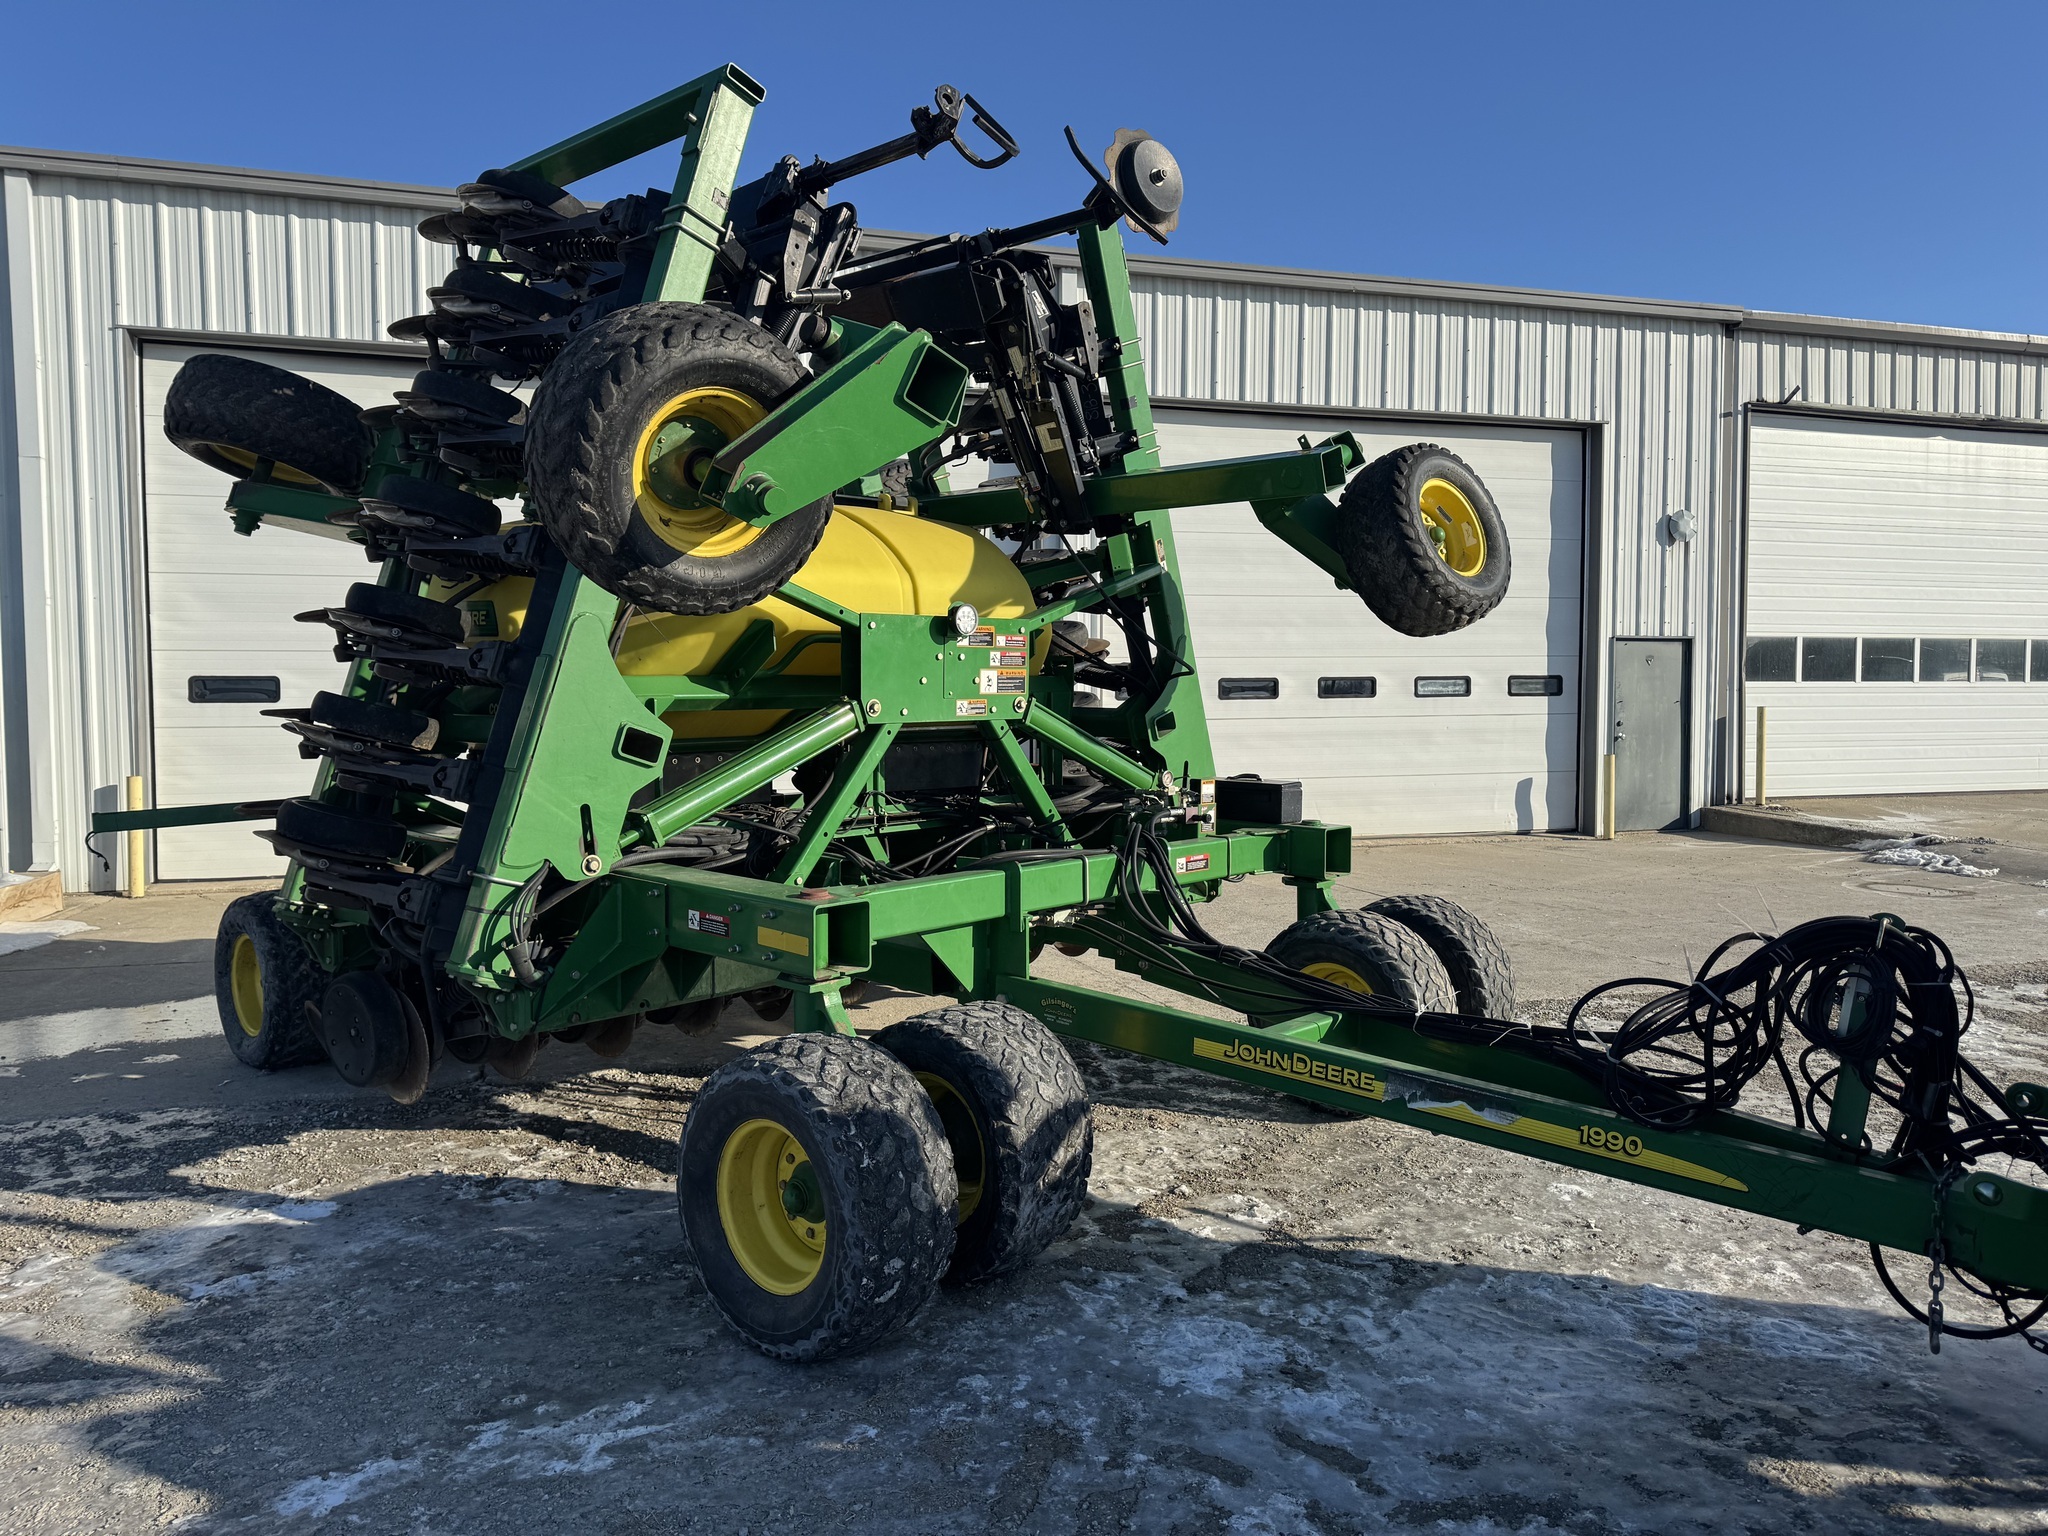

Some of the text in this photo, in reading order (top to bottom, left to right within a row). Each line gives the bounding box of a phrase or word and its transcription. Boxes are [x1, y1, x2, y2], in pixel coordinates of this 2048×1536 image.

[1224, 1038, 1376, 1092] JOHN DEERE
[1579, 1124, 1643, 1157] 1990
